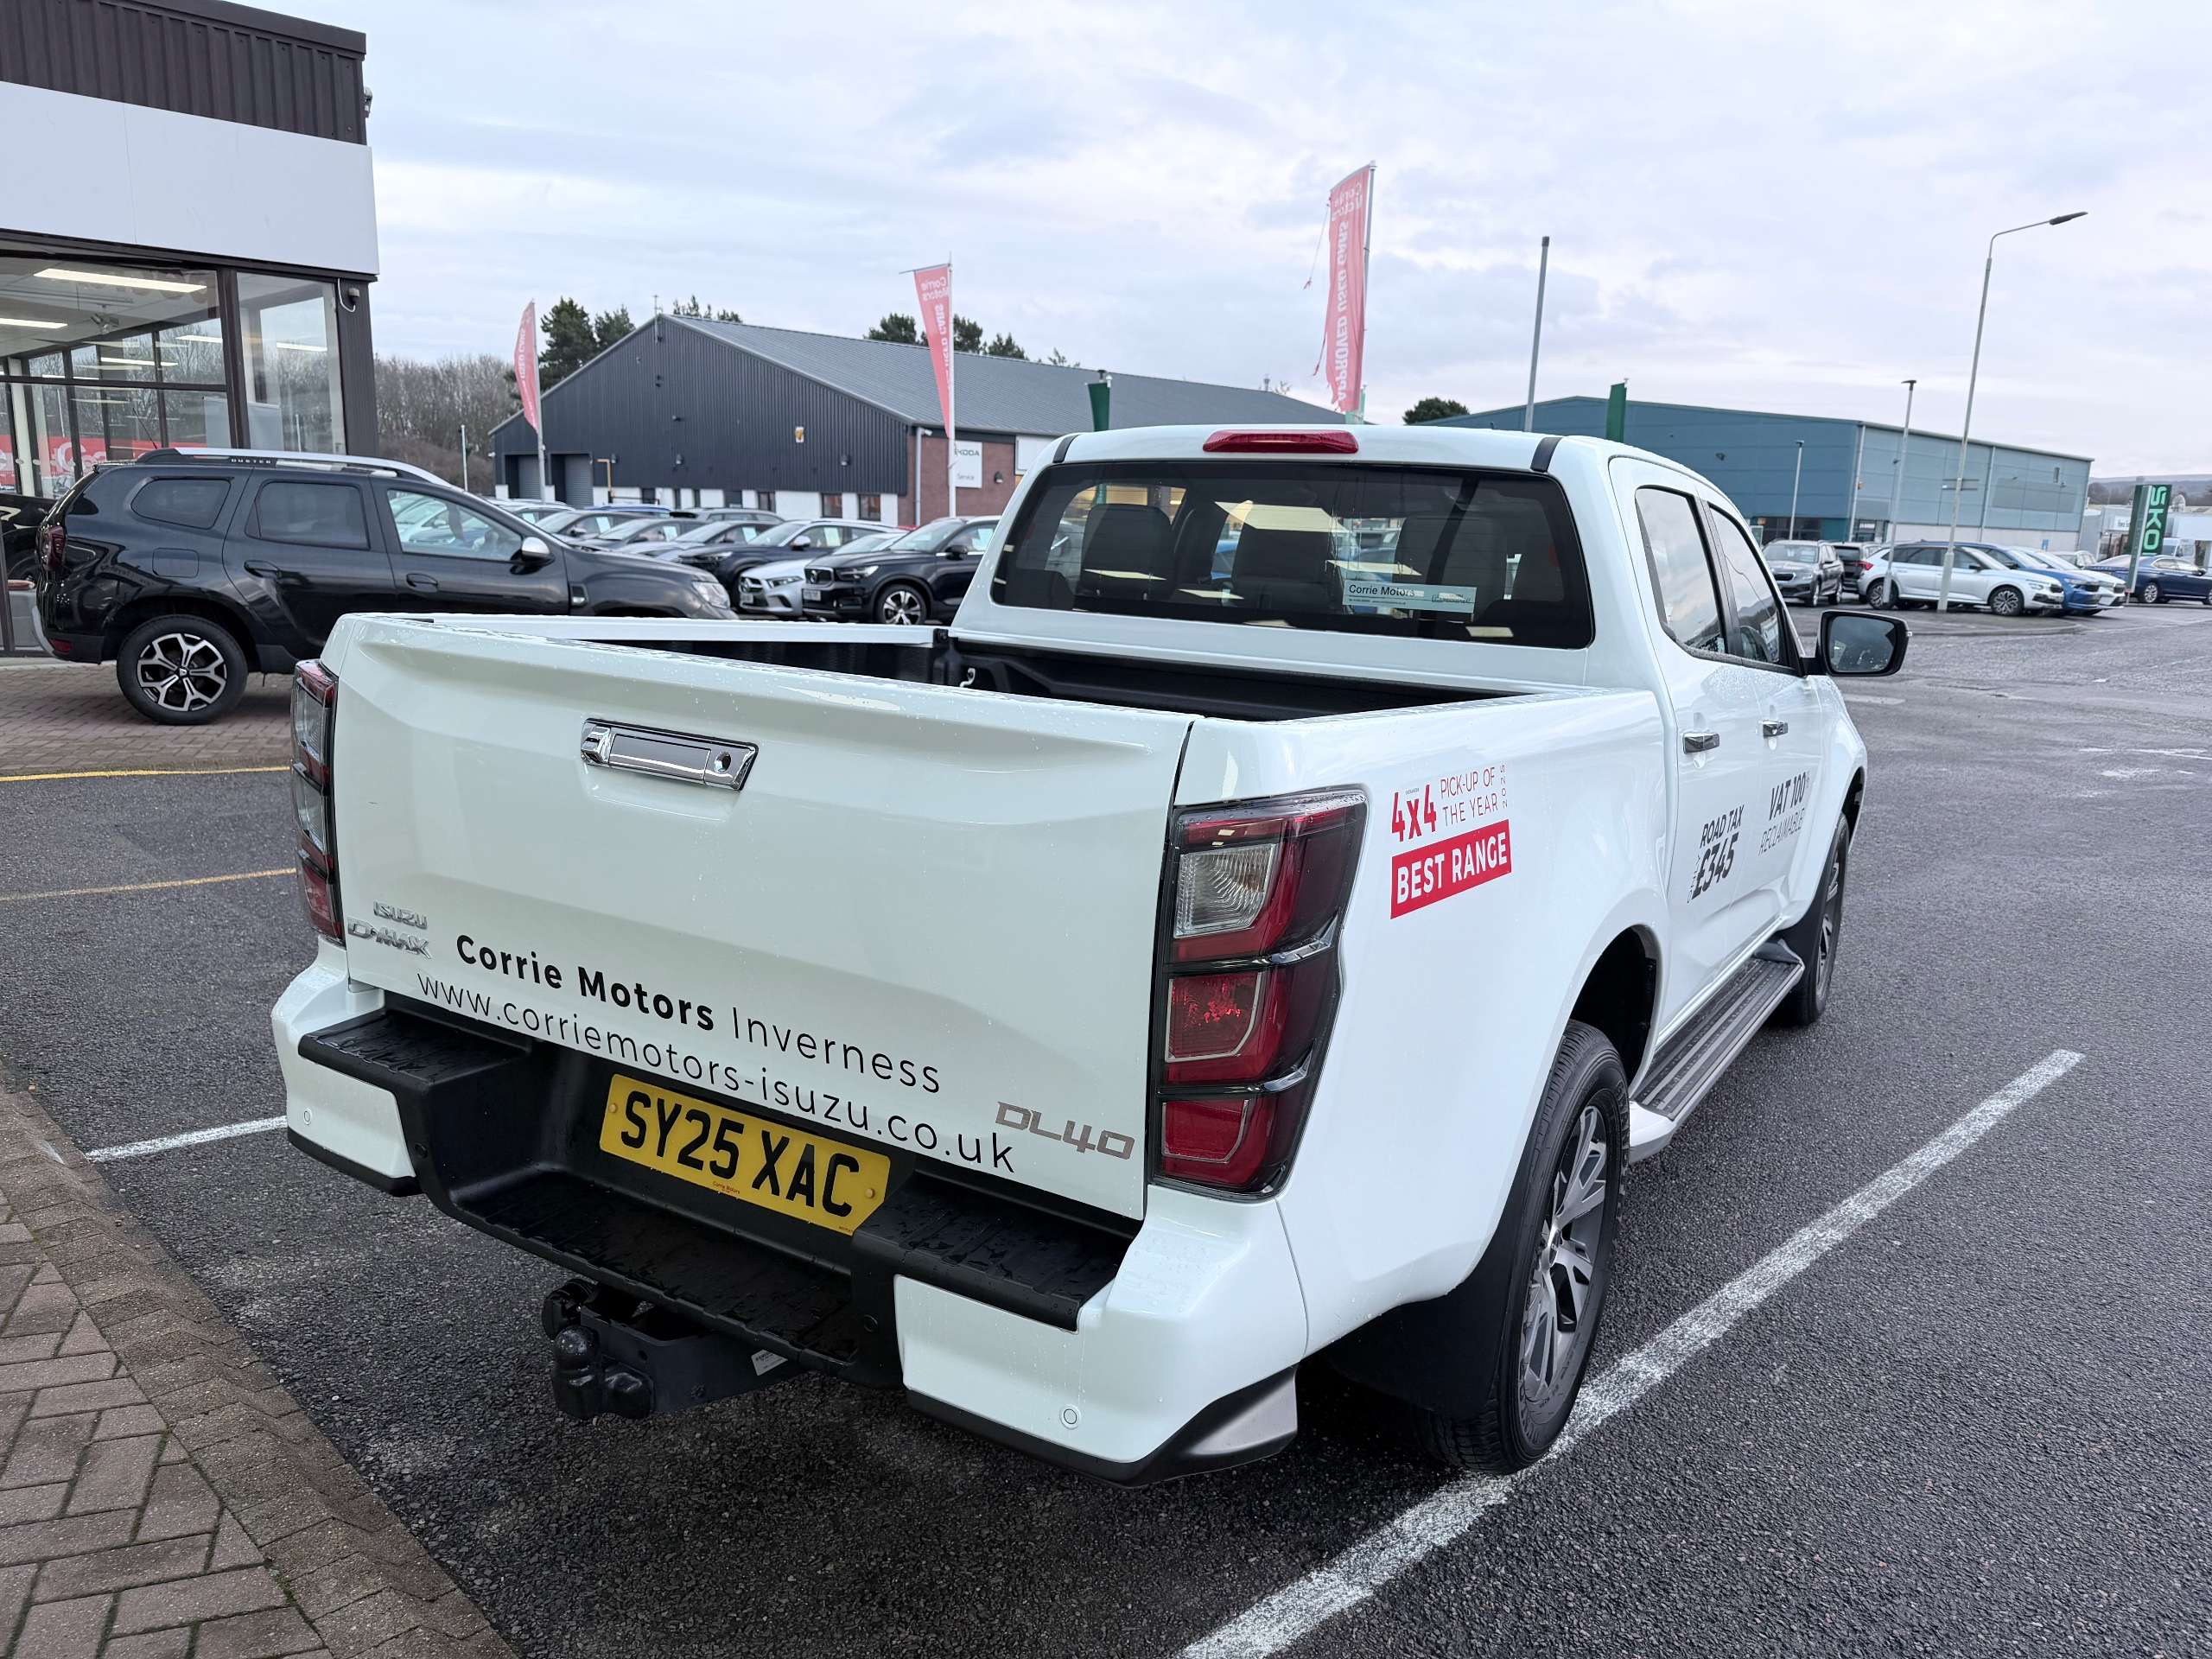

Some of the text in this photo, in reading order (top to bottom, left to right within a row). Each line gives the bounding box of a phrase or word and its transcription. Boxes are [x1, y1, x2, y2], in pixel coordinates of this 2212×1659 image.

[1349, 584, 1415, 597] Corrie Motors
[1440, 766, 1496, 799] PICK-UP OF
[1769, 779, 1792, 821] VAT
[1442, 792, 1498, 827] THE YEAR
[1700, 804, 1745, 849] ROAD TAX
[1396, 831, 1508, 905] BEST RANGE
[1691, 831, 1739, 900] £345
[347, 916, 431, 960] D-MAX
[373, 901, 428, 930] ISUZU
[456, 934, 940, 1094] Corrie Motors Inverness
[417, 973, 1015, 1173] www.corriemotors-isuzu.co.uk
[995, 1100, 1135, 1160] DL40
[620, 1090, 860, 1217] SY25 XAC
